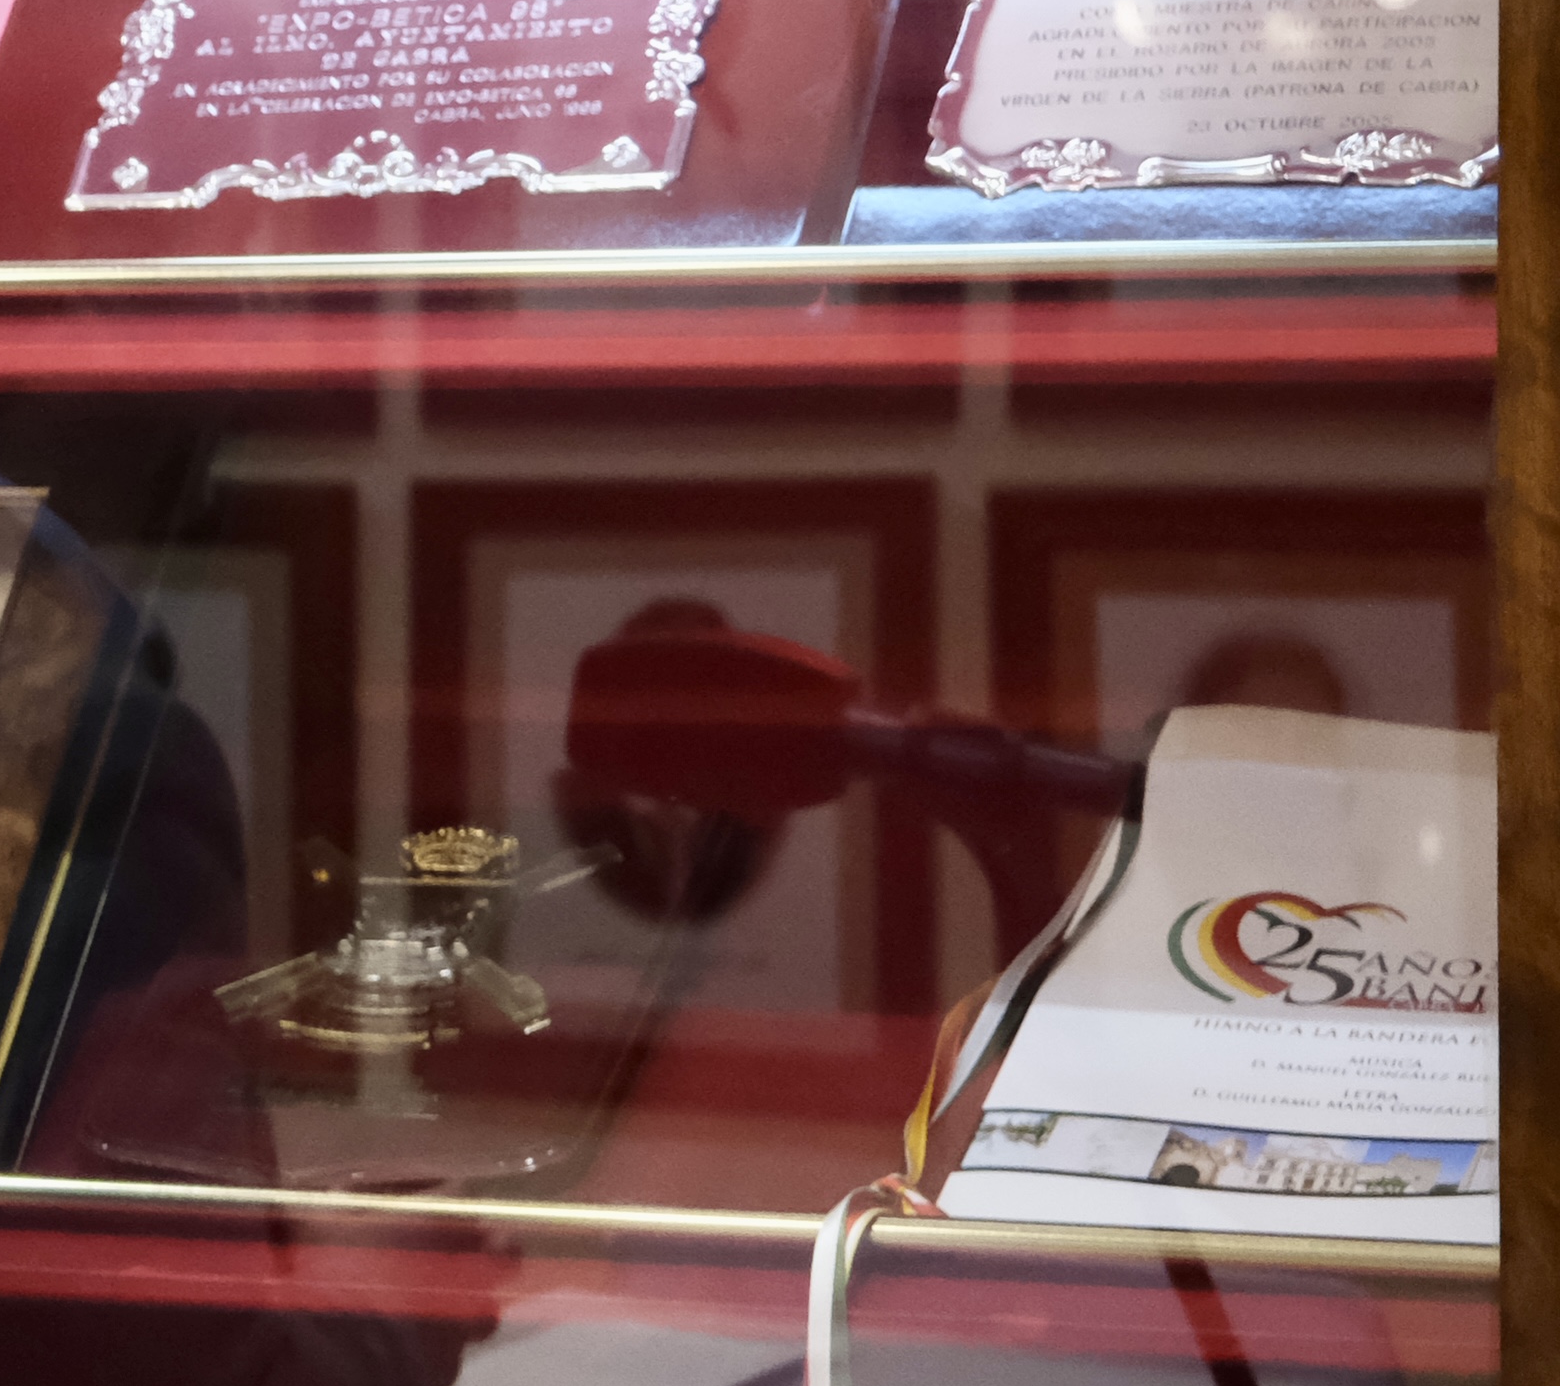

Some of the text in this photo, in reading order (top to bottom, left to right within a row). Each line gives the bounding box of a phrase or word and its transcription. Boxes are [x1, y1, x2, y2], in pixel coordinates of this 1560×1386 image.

[1318, 11, 1482, 34] PARTICIPACION
[196, 36, 234, 57] AL
[354, 16, 614, 49] AYUNTAMIENTO
[321, 46, 470, 71] DE CABRA
[1174, 59, 1221, 77] POR
[1229, 59, 1259, 76] LA
[1271, 54, 1354, 75] IMAGEN
[1363, 54, 1396, 72] DE
[1404, 53, 1435, 72] LA
[172, 60, 614, 99] EN AGRADECIMIENTO POR SU COLABORACION
[999, 90, 1073, 109] VIRGEN
[1080, 87, 1111, 105] DE
[1157, 80, 1234, 102] SIERRA
[1242, 76, 1348, 100] (PATRONA
[1357, 77, 1388, 95] DE
[195, 101, 219, 118] EN
[226, 99, 253, 116] LA
[1223, 113, 1328, 134] OCTUBRE
[1251, 916, 1498, 1006] 25 AÑO
[1192, 1016, 1283, 1035] HIMNO
[1314, 1025, 1339, 1040] LA
[1347, 1026, 1461, 1047] BANDERA
[1276, 1060, 1348, 1078] MANUEL
[1216, 1088, 1322, 1108] GUILLERMO
[1342, 1087, 1401, 1104] LETRA
